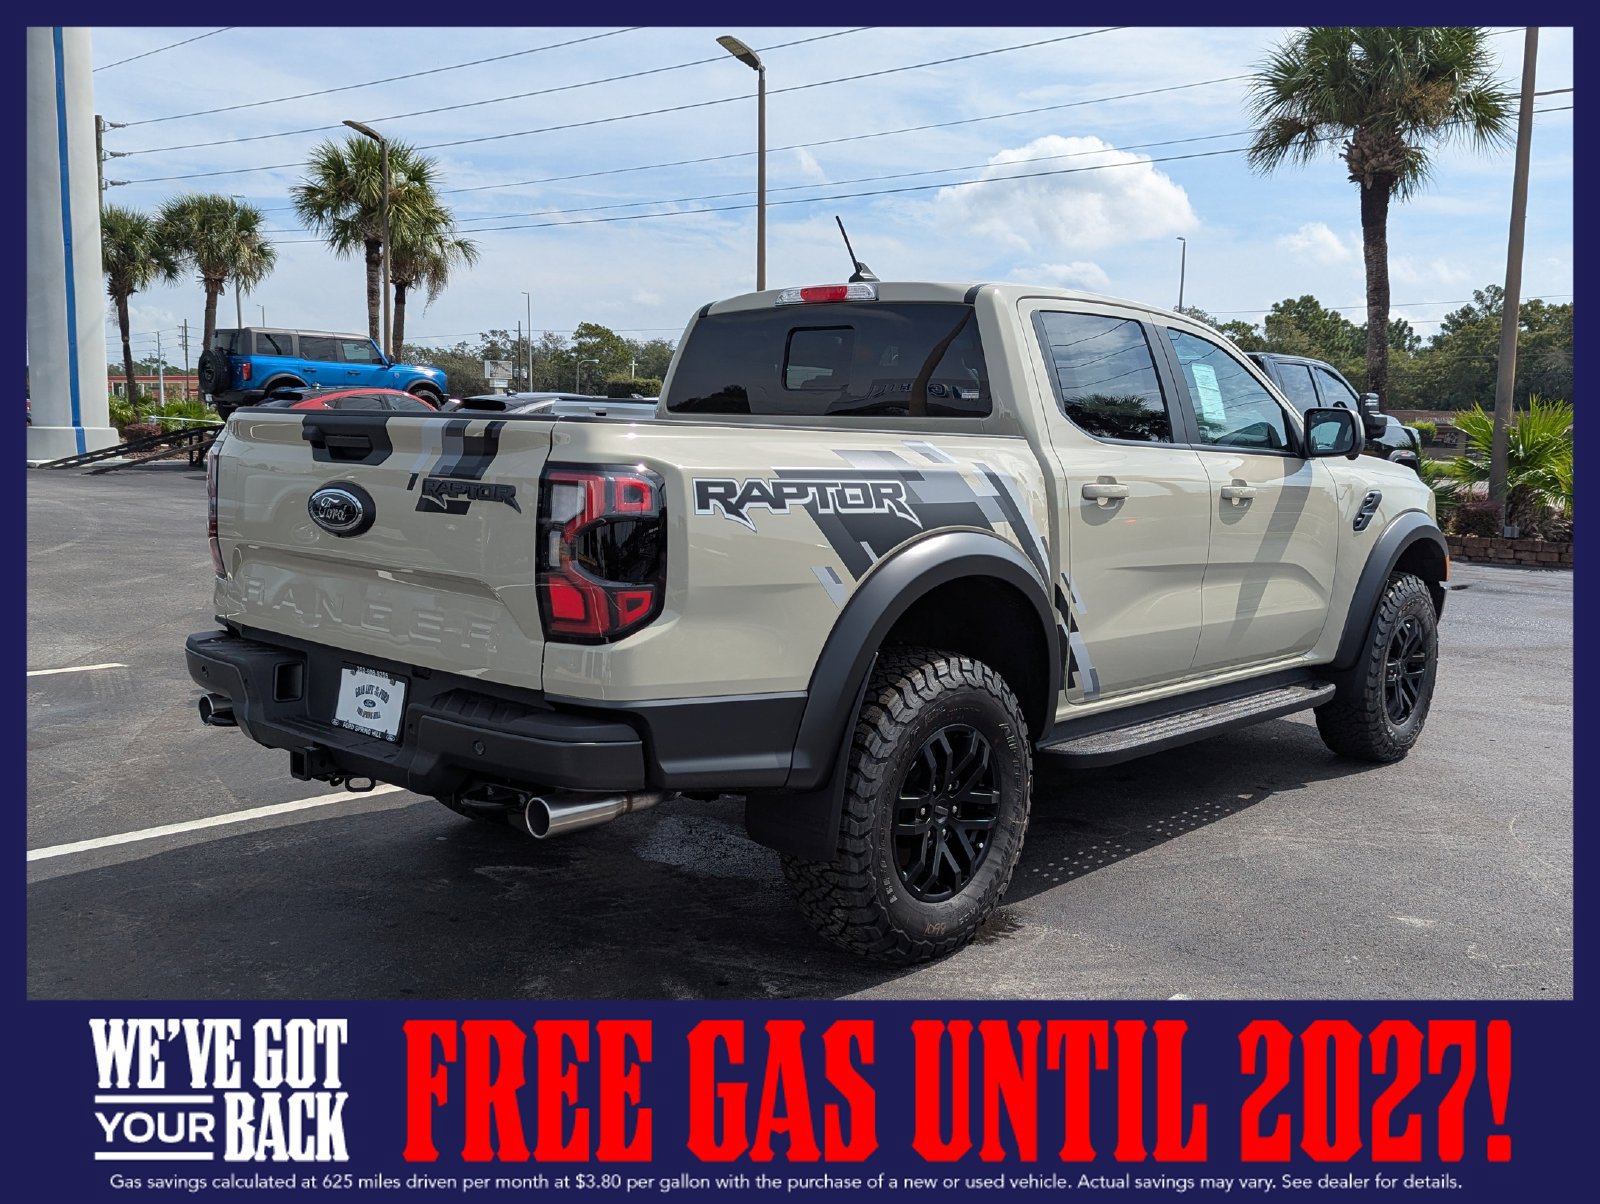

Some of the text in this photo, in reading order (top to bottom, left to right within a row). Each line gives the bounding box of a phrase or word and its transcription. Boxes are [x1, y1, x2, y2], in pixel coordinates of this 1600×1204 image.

[317, 496, 348, 521] Ford
[422, 478, 522, 514] RAPTOR
[692, 477, 923, 533] RAPTOR
[241, 575, 498, 654] RANGER
[342, 722, 355, 730] FORD
[354, 725, 371, 735] SPRING
[371, 730, 382, 739] HILL
